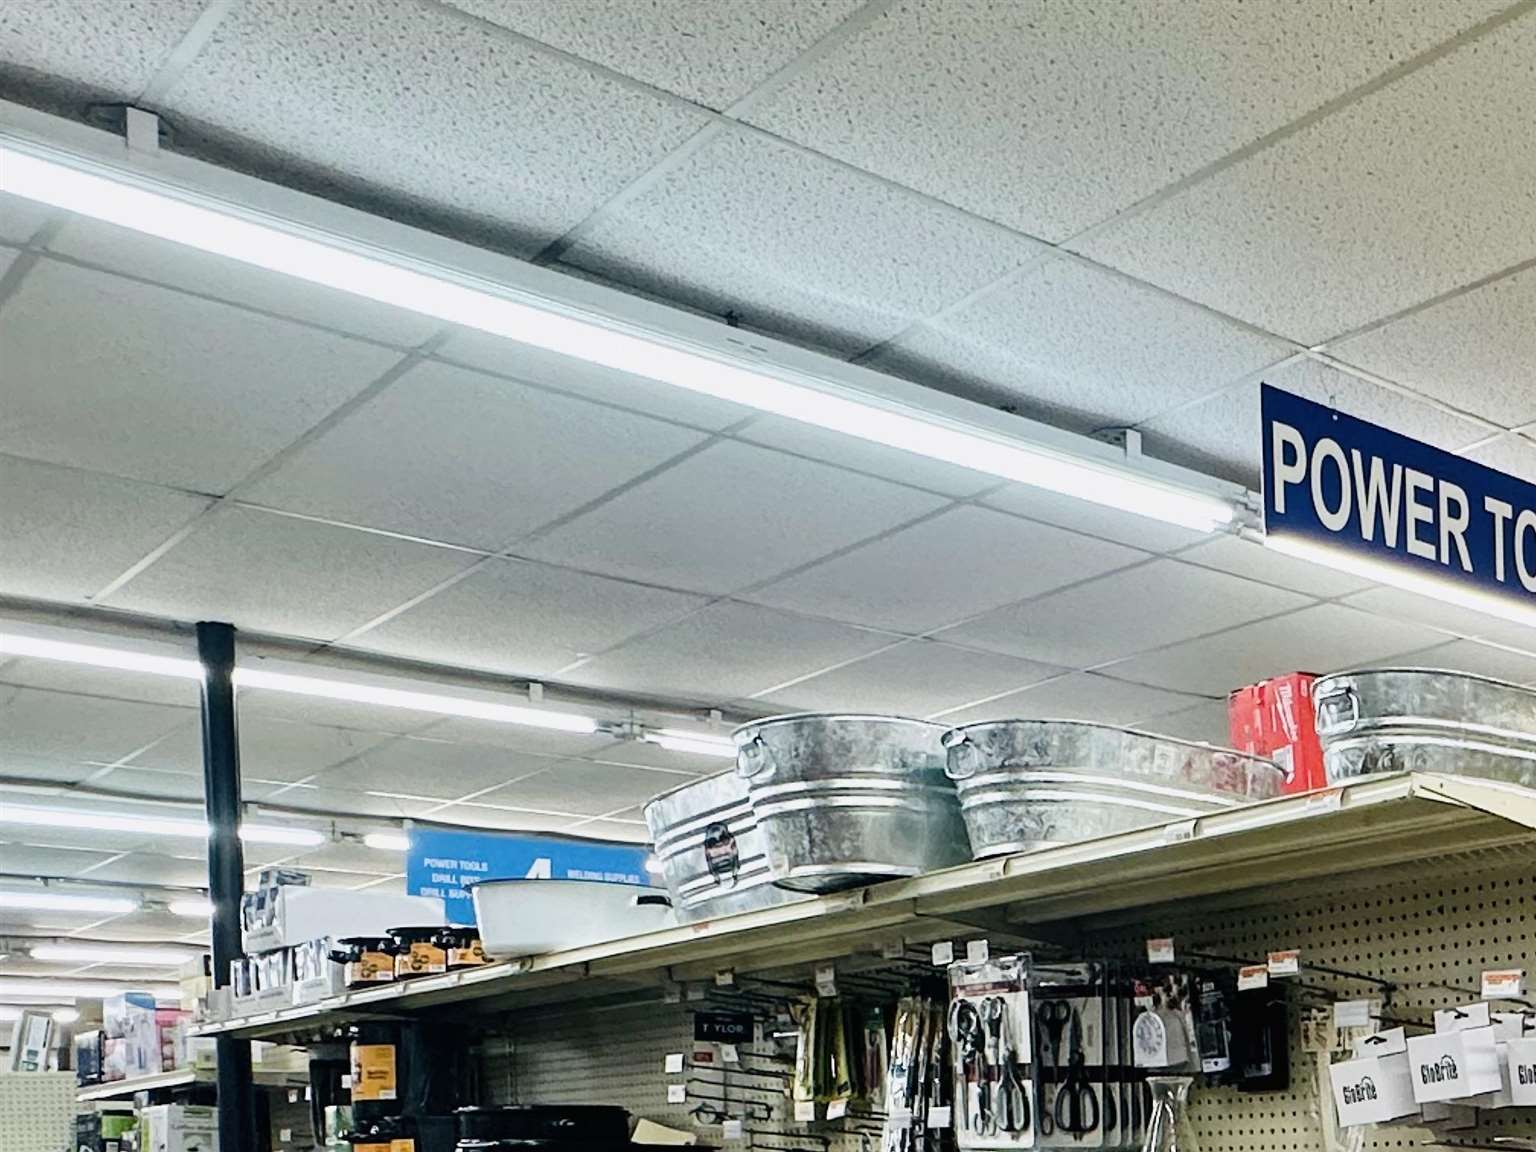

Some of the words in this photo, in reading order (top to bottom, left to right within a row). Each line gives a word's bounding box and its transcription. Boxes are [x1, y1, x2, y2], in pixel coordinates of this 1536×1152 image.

[1272, 420, 1473, 572] POWER
[424, 858, 457, 870] POWER
[460, 860, 488, 872] TOOLS
[703, 1024, 744, 1034] TYLOR
[1421, 1055, 1458, 1085] GloBrite
